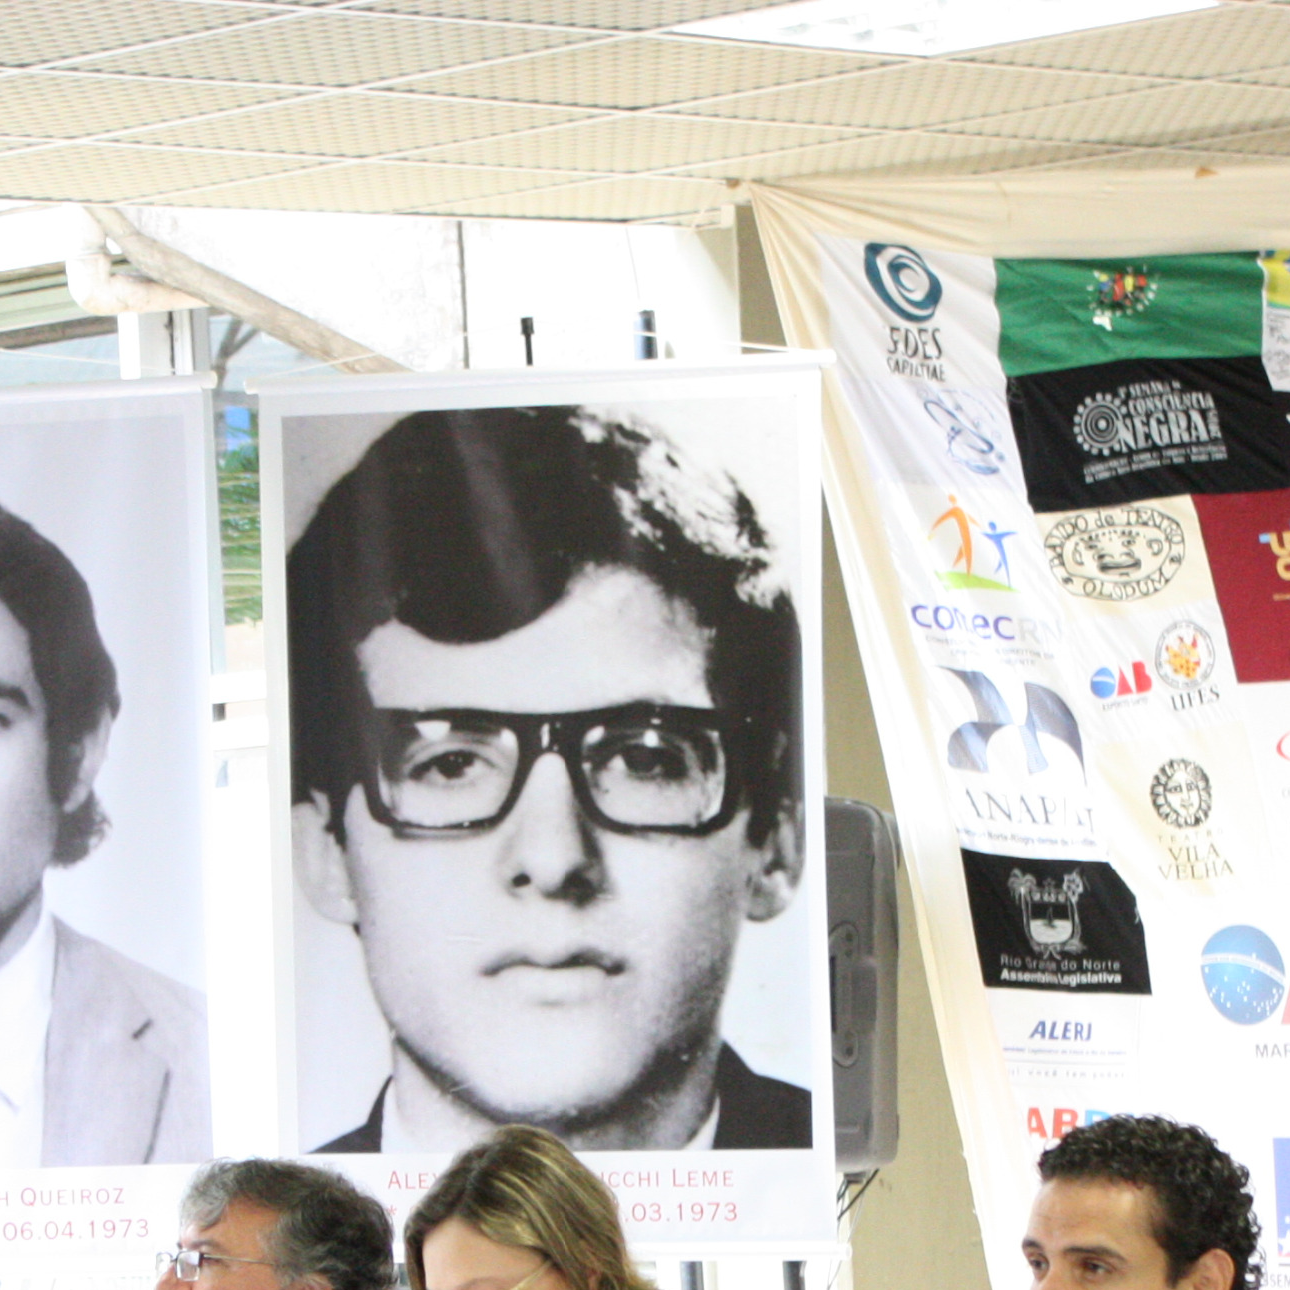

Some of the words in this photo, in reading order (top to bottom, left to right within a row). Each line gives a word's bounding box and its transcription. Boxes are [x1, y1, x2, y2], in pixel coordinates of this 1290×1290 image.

[1115, 408, 1209, 453] NEGRA
[1168, 842, 1220, 863] VILA
[1158, 859, 1234, 880] VELHA
[1000, 953, 1022, 967] Rio
[1061, 959, 1077, 971] do
[1083, 959, 1120, 971] Norte
[1029, 1020, 1092, 1042] ALERJ
[672, 1169, 735, 1188] LEME
[20, 1187, 125, 1206] QUEIROZ
[624, 1202, 739, 1223] .03.1973
[3, 1219, 149, 1241] 06.04.1973
